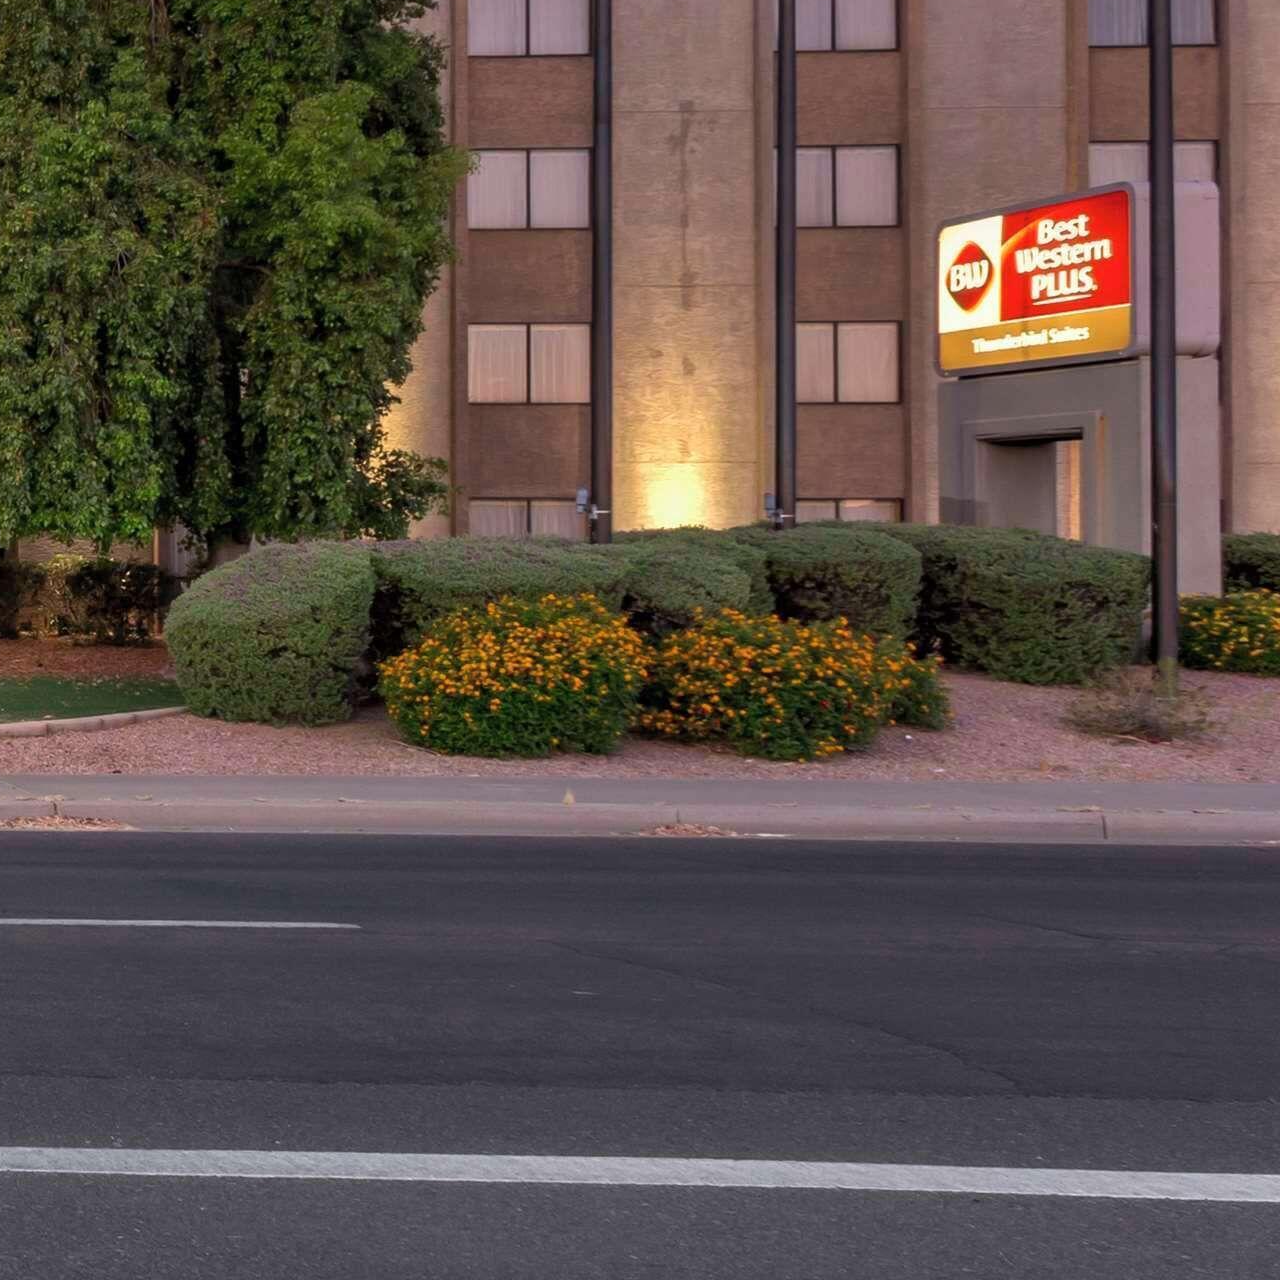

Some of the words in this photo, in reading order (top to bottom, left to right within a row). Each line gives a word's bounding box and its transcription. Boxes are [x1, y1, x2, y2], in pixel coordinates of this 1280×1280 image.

[1037, 214, 1090, 244] Best
[1015, 239, 1113, 273] Western
[950, 259, 989, 292] BW
